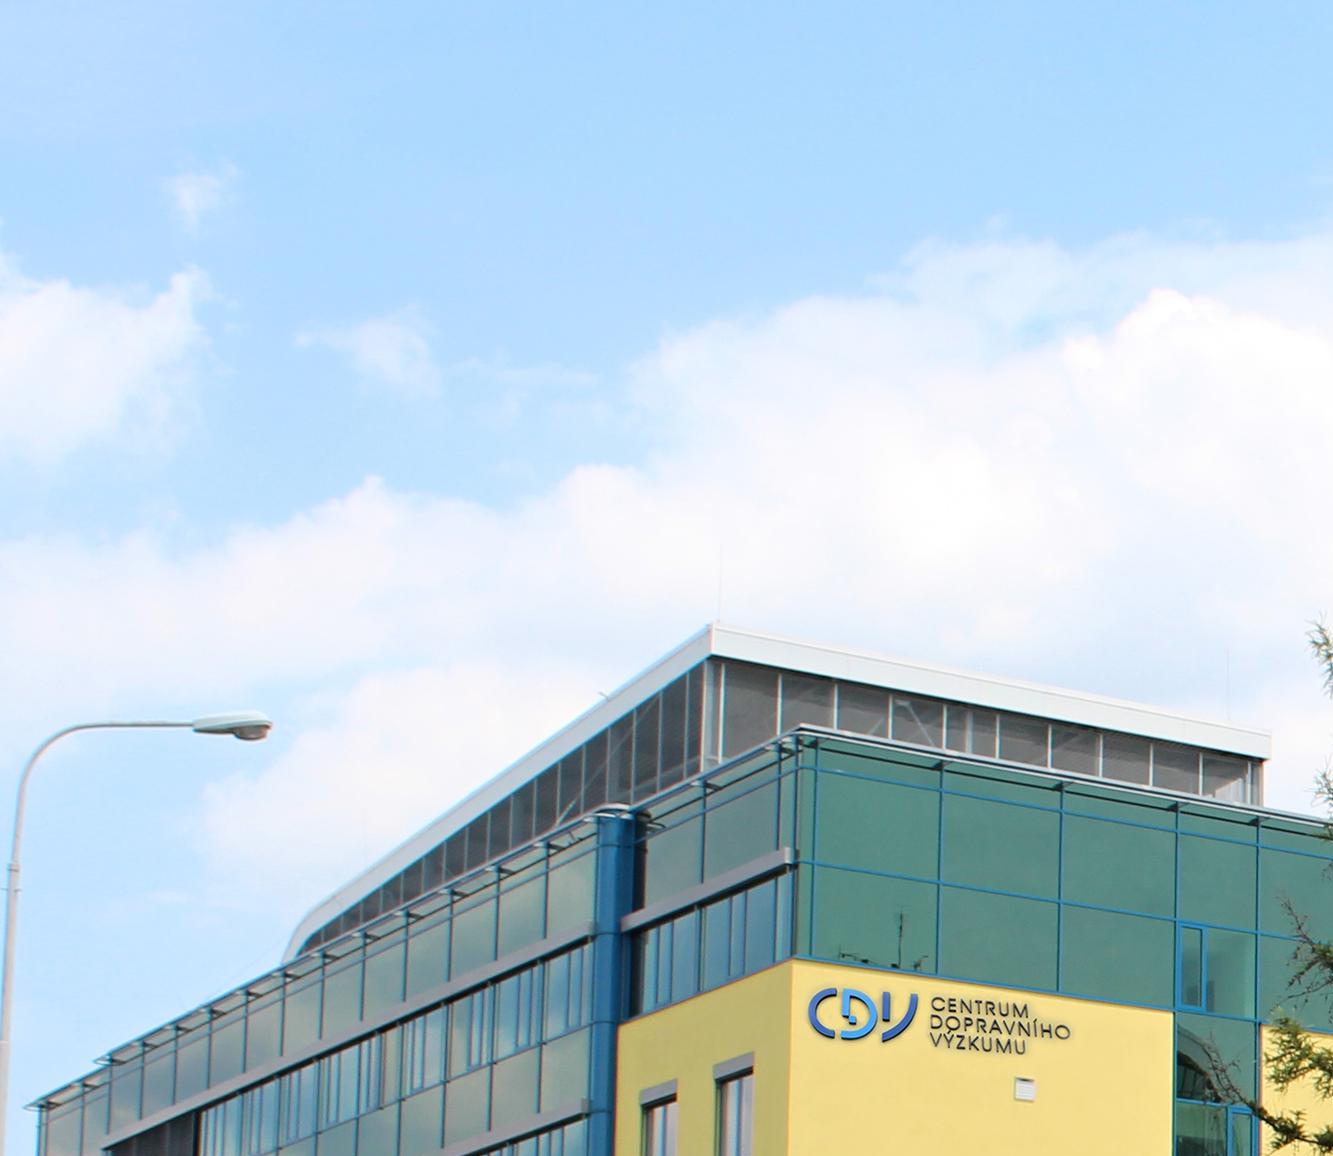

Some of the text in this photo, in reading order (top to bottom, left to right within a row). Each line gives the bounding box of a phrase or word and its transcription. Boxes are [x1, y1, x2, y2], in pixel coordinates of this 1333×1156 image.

[930, 996, 1029, 1018] CENTRUM
[930, 1014, 1071, 1040] DOPRAVNÍHO
[929, 1031, 1026, 1055] VÝZKUMU
